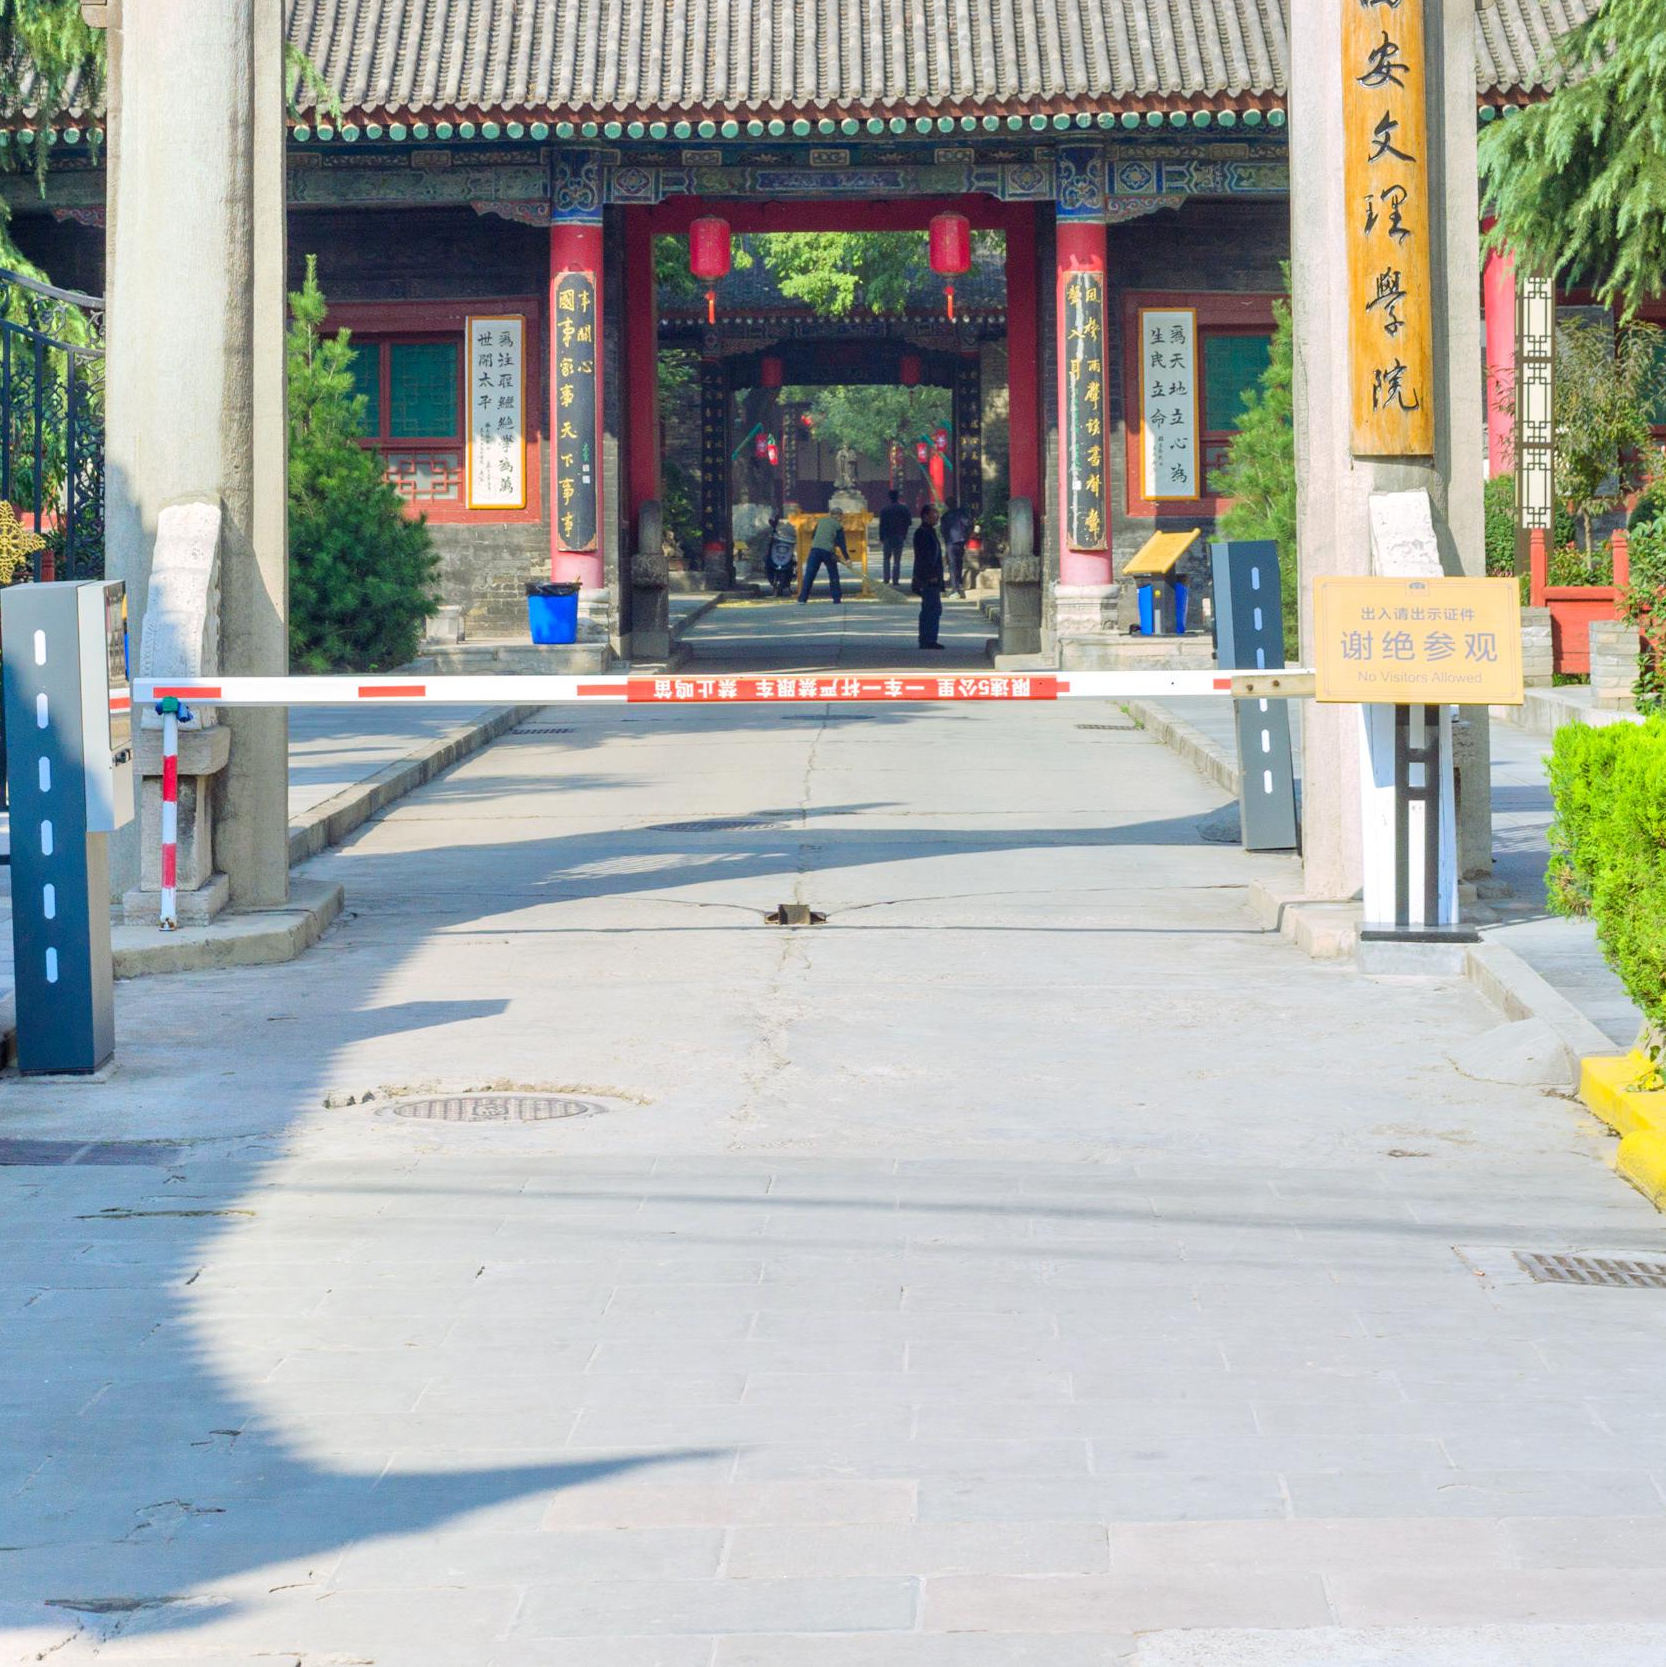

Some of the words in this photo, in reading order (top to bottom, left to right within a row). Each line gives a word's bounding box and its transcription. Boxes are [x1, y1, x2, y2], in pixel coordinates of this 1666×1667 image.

[1360, 607, 1476, 622] 出入请出示证件
[1340, 630, 1499, 663] 谢绝参观
[653, 677, 738, 700] 禁止鸣笛
[755, 676, 925, 699] 一车一杆严禁跟车
[937, 676, 1031, 699] 限速5公里
[1358, 670, 1377, 682] No
[1381, 670, 1428, 683] Visitors
[1432, 671, 1483, 684] Allowed
